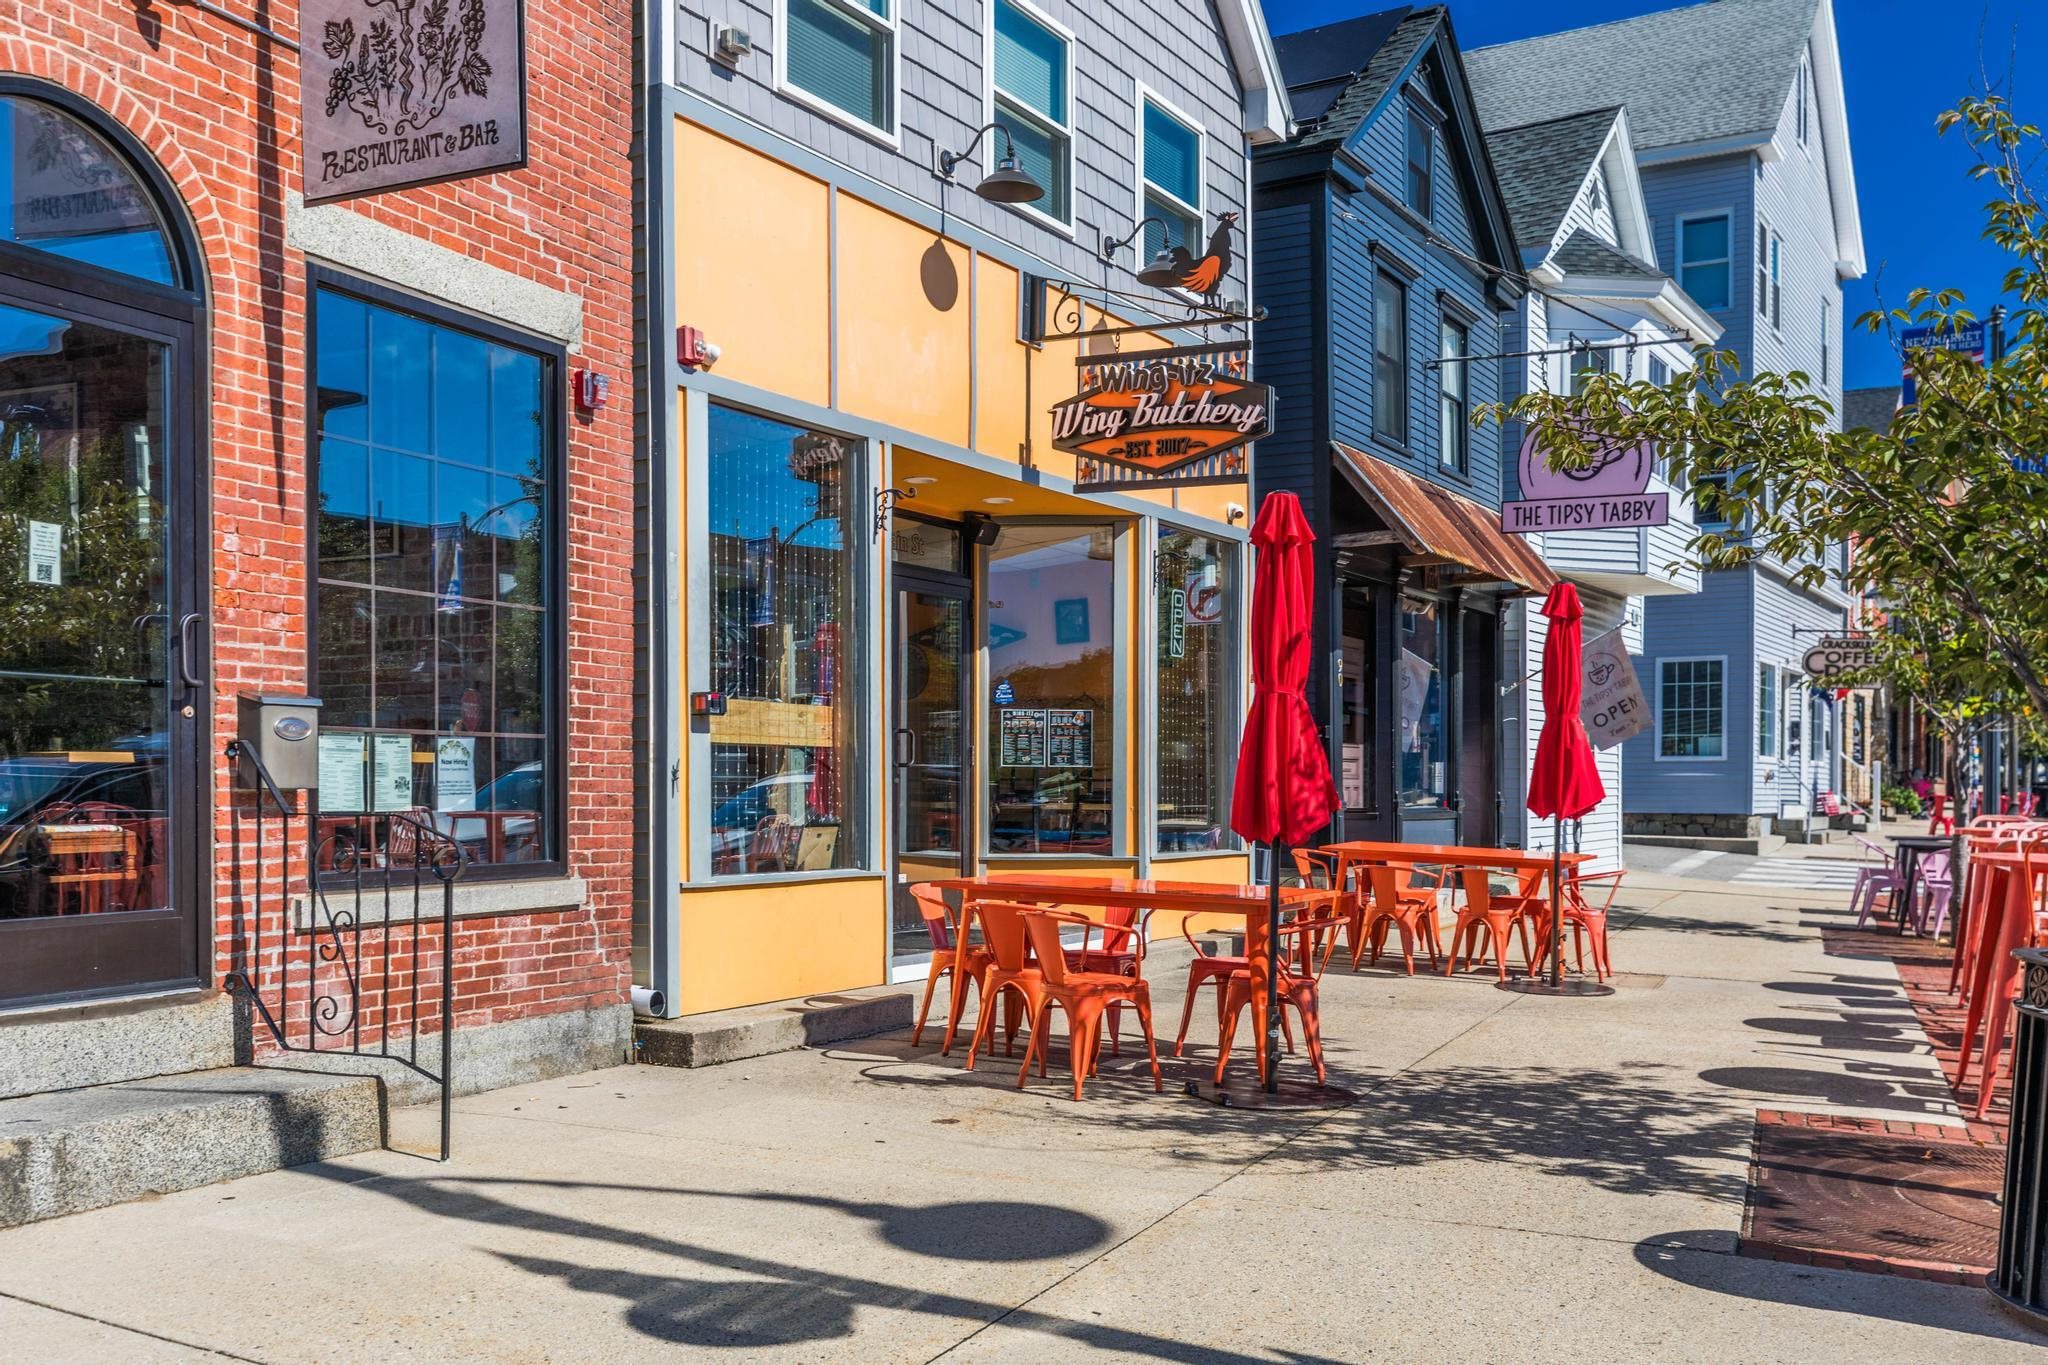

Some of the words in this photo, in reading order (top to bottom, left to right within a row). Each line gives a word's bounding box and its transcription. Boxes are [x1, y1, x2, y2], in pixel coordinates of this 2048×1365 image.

[321, 132, 444, 182] RESTAURANT
[444, 134, 457, 154] &
[457, 119, 499, 152] BAR
[1100, 357, 1215, 393] Wing-itz
[1048, 401, 1127, 440] Wing
[1130, 390, 1267, 433] Butchery
[1124, 439, 1153, 458] EST.
[1513, 505, 1543, 527] THE
[1547, 503, 1596, 525] TIPSY
[1600, 500, 1656, 523] TABBY
[1173, 594, 1183, 654] OPEN
[1805, 651, 1883, 674] COFFEE
[1593, 695, 1638, 727] OPEN
